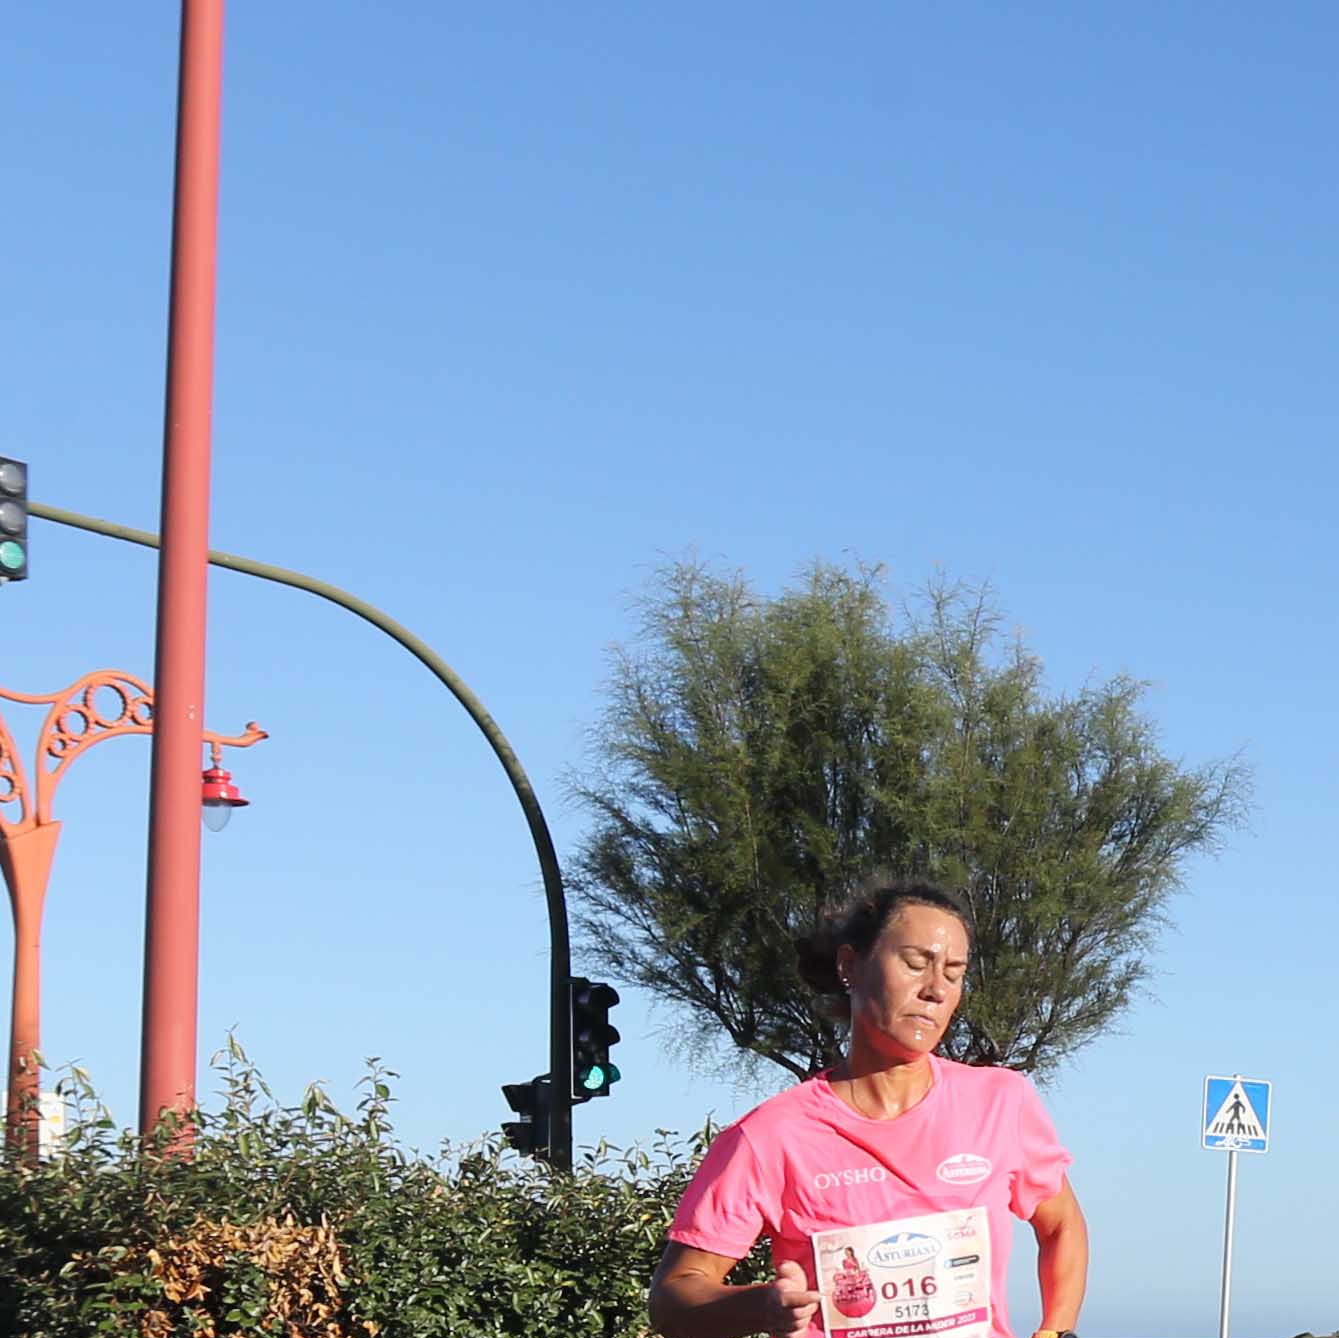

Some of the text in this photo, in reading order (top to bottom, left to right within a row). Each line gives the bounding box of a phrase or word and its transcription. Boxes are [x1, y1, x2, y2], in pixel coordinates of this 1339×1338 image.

[814, 1166, 886, 1190] OYSHO
[881, 1275, 938, 1300] 016
[895, 1303, 930, 1319] 5173
[847, 1327, 893, 1338] CARRERA
[895, 1324, 910, 1335] DE
[911, 1323, 925, 1333] LA
